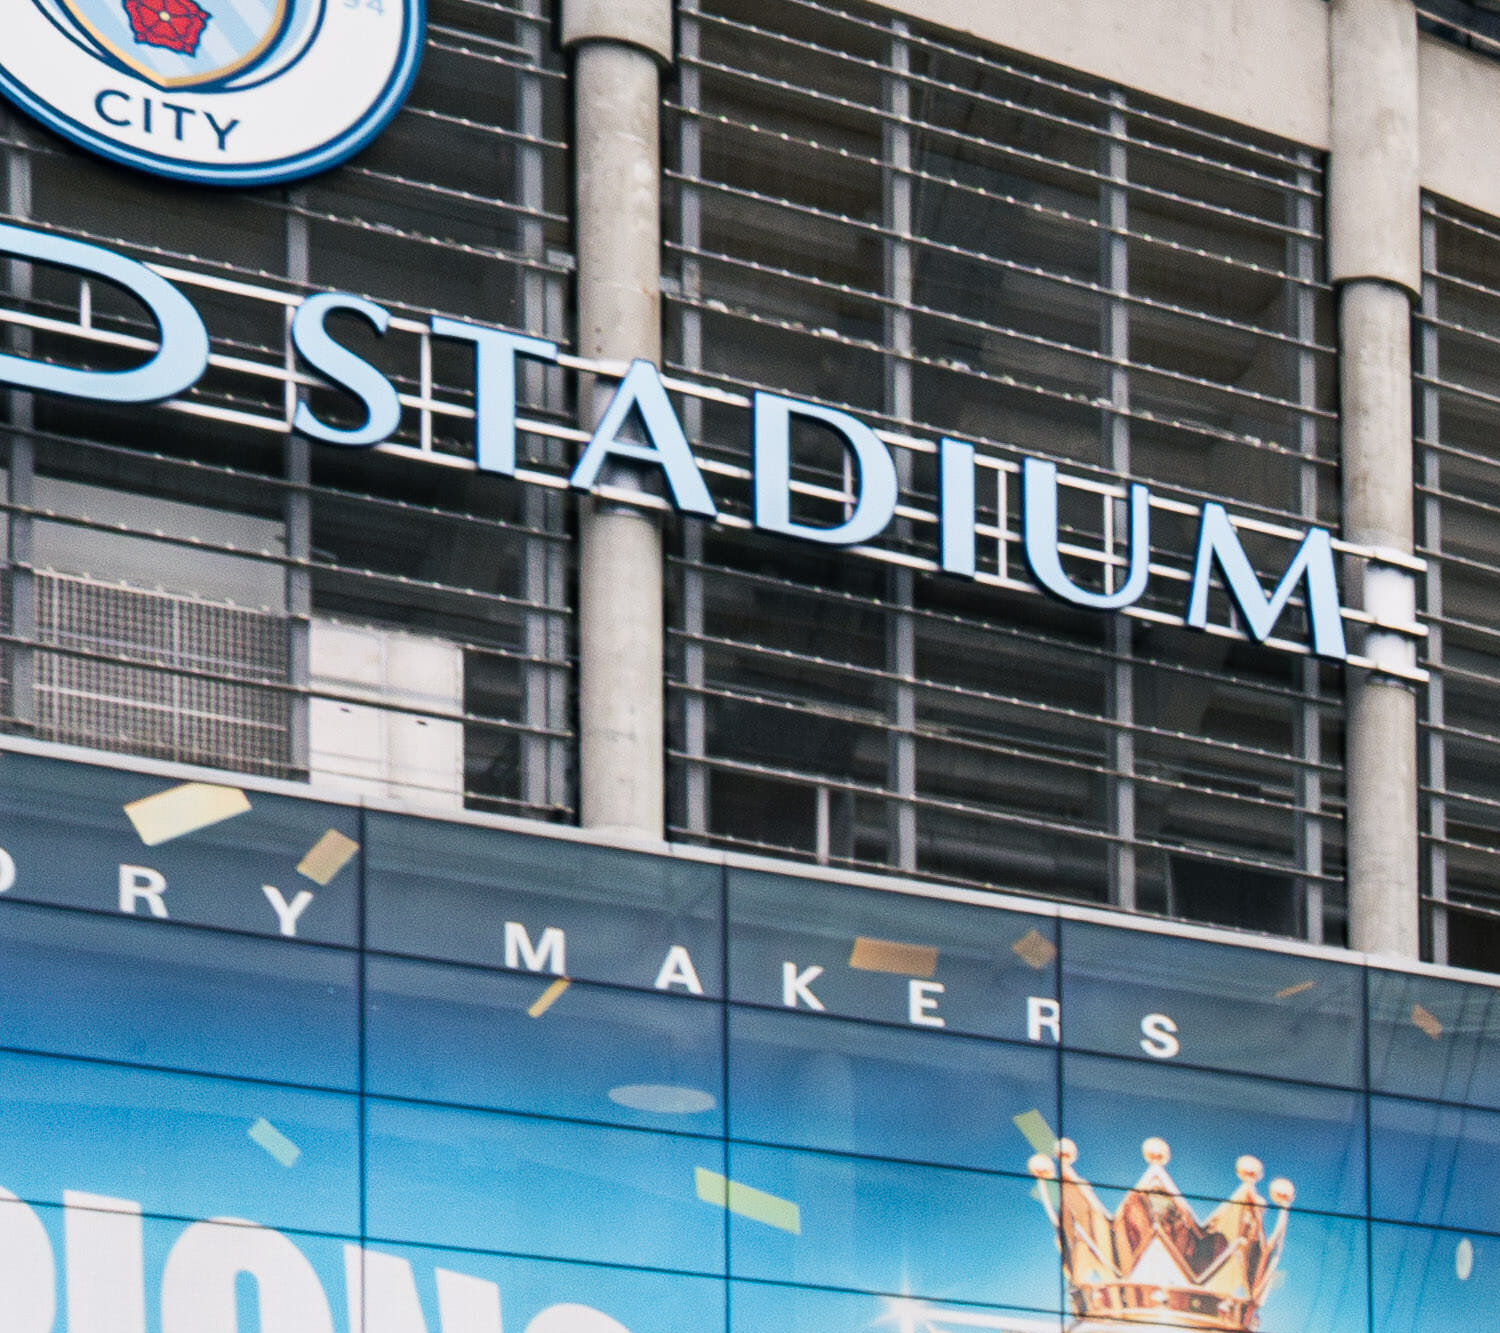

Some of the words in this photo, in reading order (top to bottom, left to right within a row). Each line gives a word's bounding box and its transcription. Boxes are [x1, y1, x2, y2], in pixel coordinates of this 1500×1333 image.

[93, 88, 241, 152] CITY
[291, 291, 1348, 662] STADIUM
[503, 920, 1180, 1060] MAKERS
